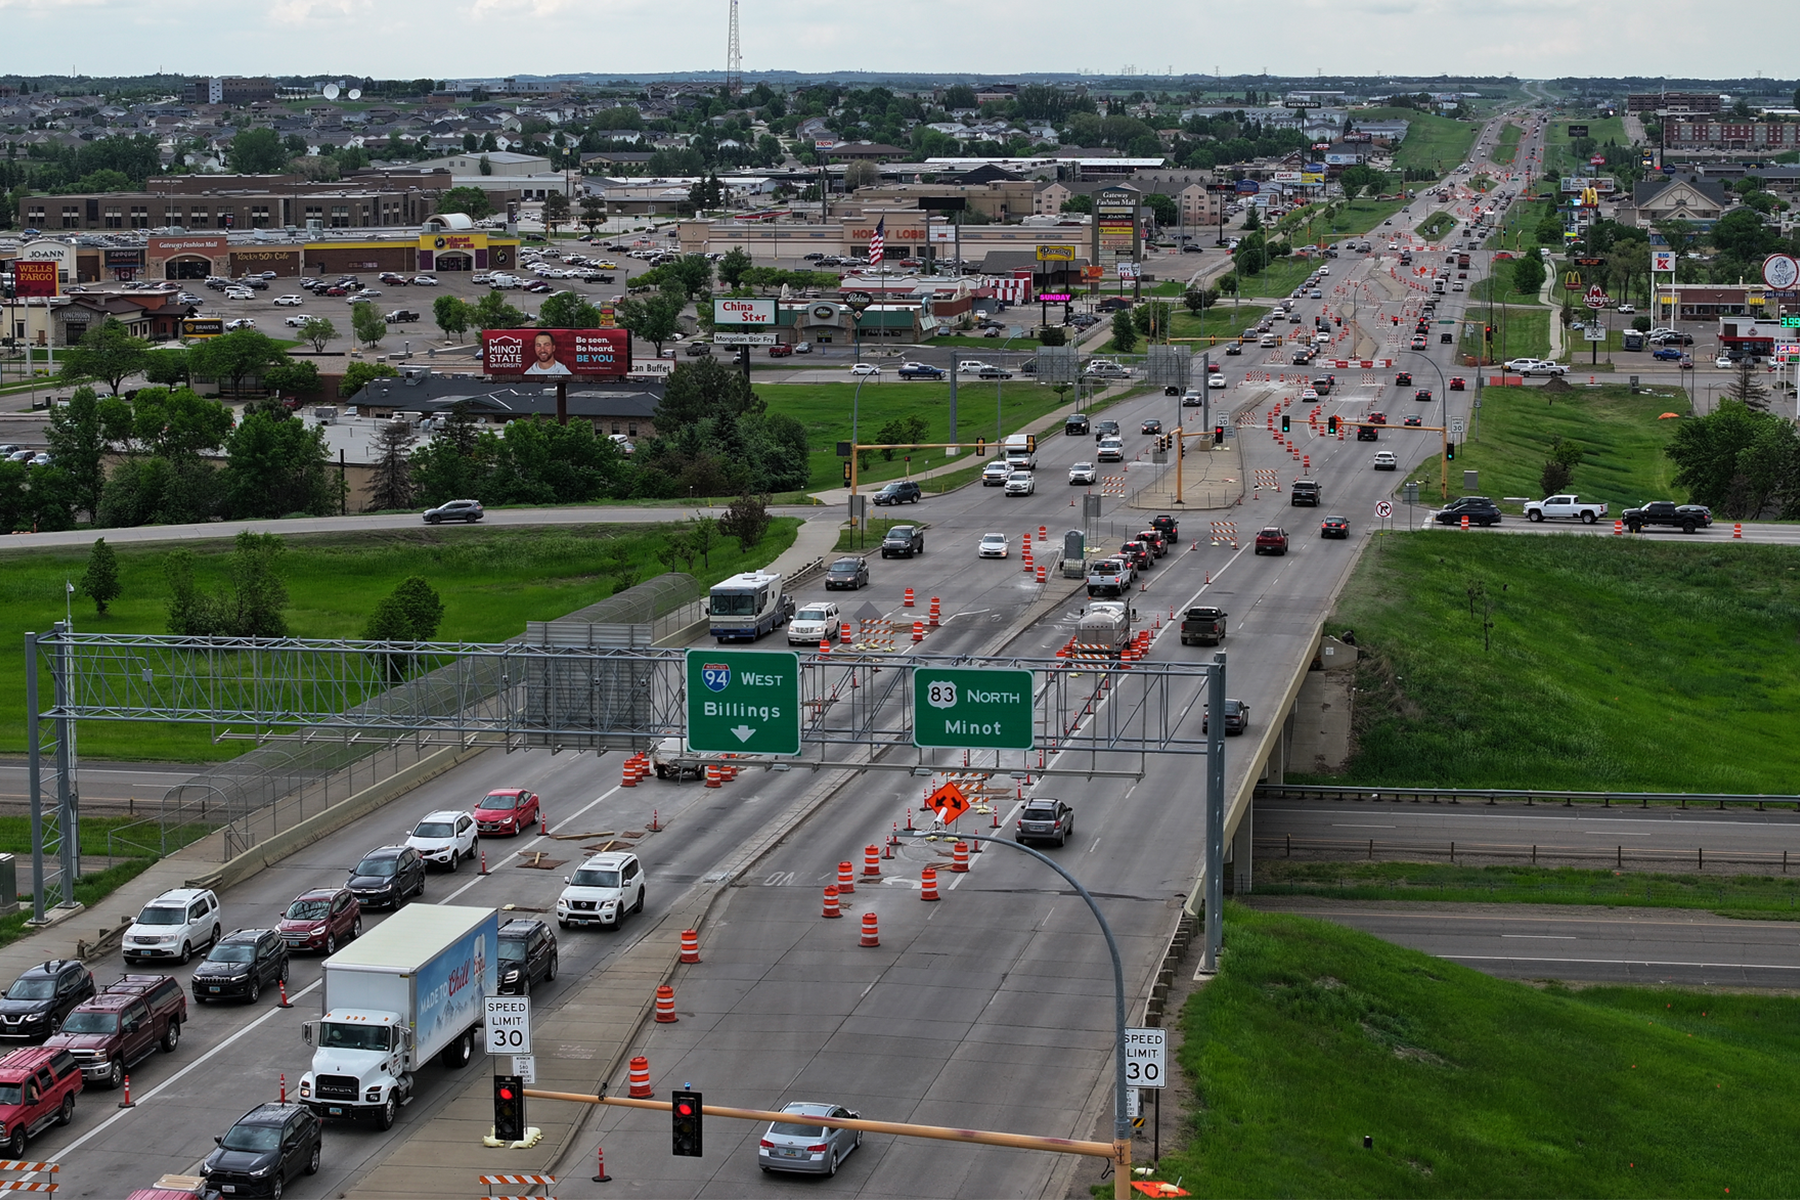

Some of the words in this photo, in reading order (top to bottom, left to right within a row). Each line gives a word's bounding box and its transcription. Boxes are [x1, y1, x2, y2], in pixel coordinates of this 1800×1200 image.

[852, 230, 890, 238] HOBY
[1583, 294, 1609, 304] Arby's
[723, 302, 753, 311] China
[489, 345, 522, 354] MINOT
[489, 354, 522, 362] STATE
[591, 354, 615, 362] YOU.
[647, 364, 670, 372] Buffet
[705, 671, 727, 686] 94
[741, 672, 783, 686] WEST
[931, 687, 954, 702] 83
[967, 690, 1020, 704] NORTH
[704, 702, 780, 722] Billings
[945, 720, 1001, 735] Minot
[420, 990, 438, 1016] MADE
[440, 982, 448, 1000] TO
[449, 958, 470, 997] Chill
[488, 1003, 526, 1012] SPEED
[492, 1017, 522, 1026] LIMIT
[494, 1030, 522, 1046] 30
[1125, 1034, 1162, 1044] SPEED
[1127, 1049, 1157, 1058] LIMIT
[1127, 1062, 1158, 1080] 30
